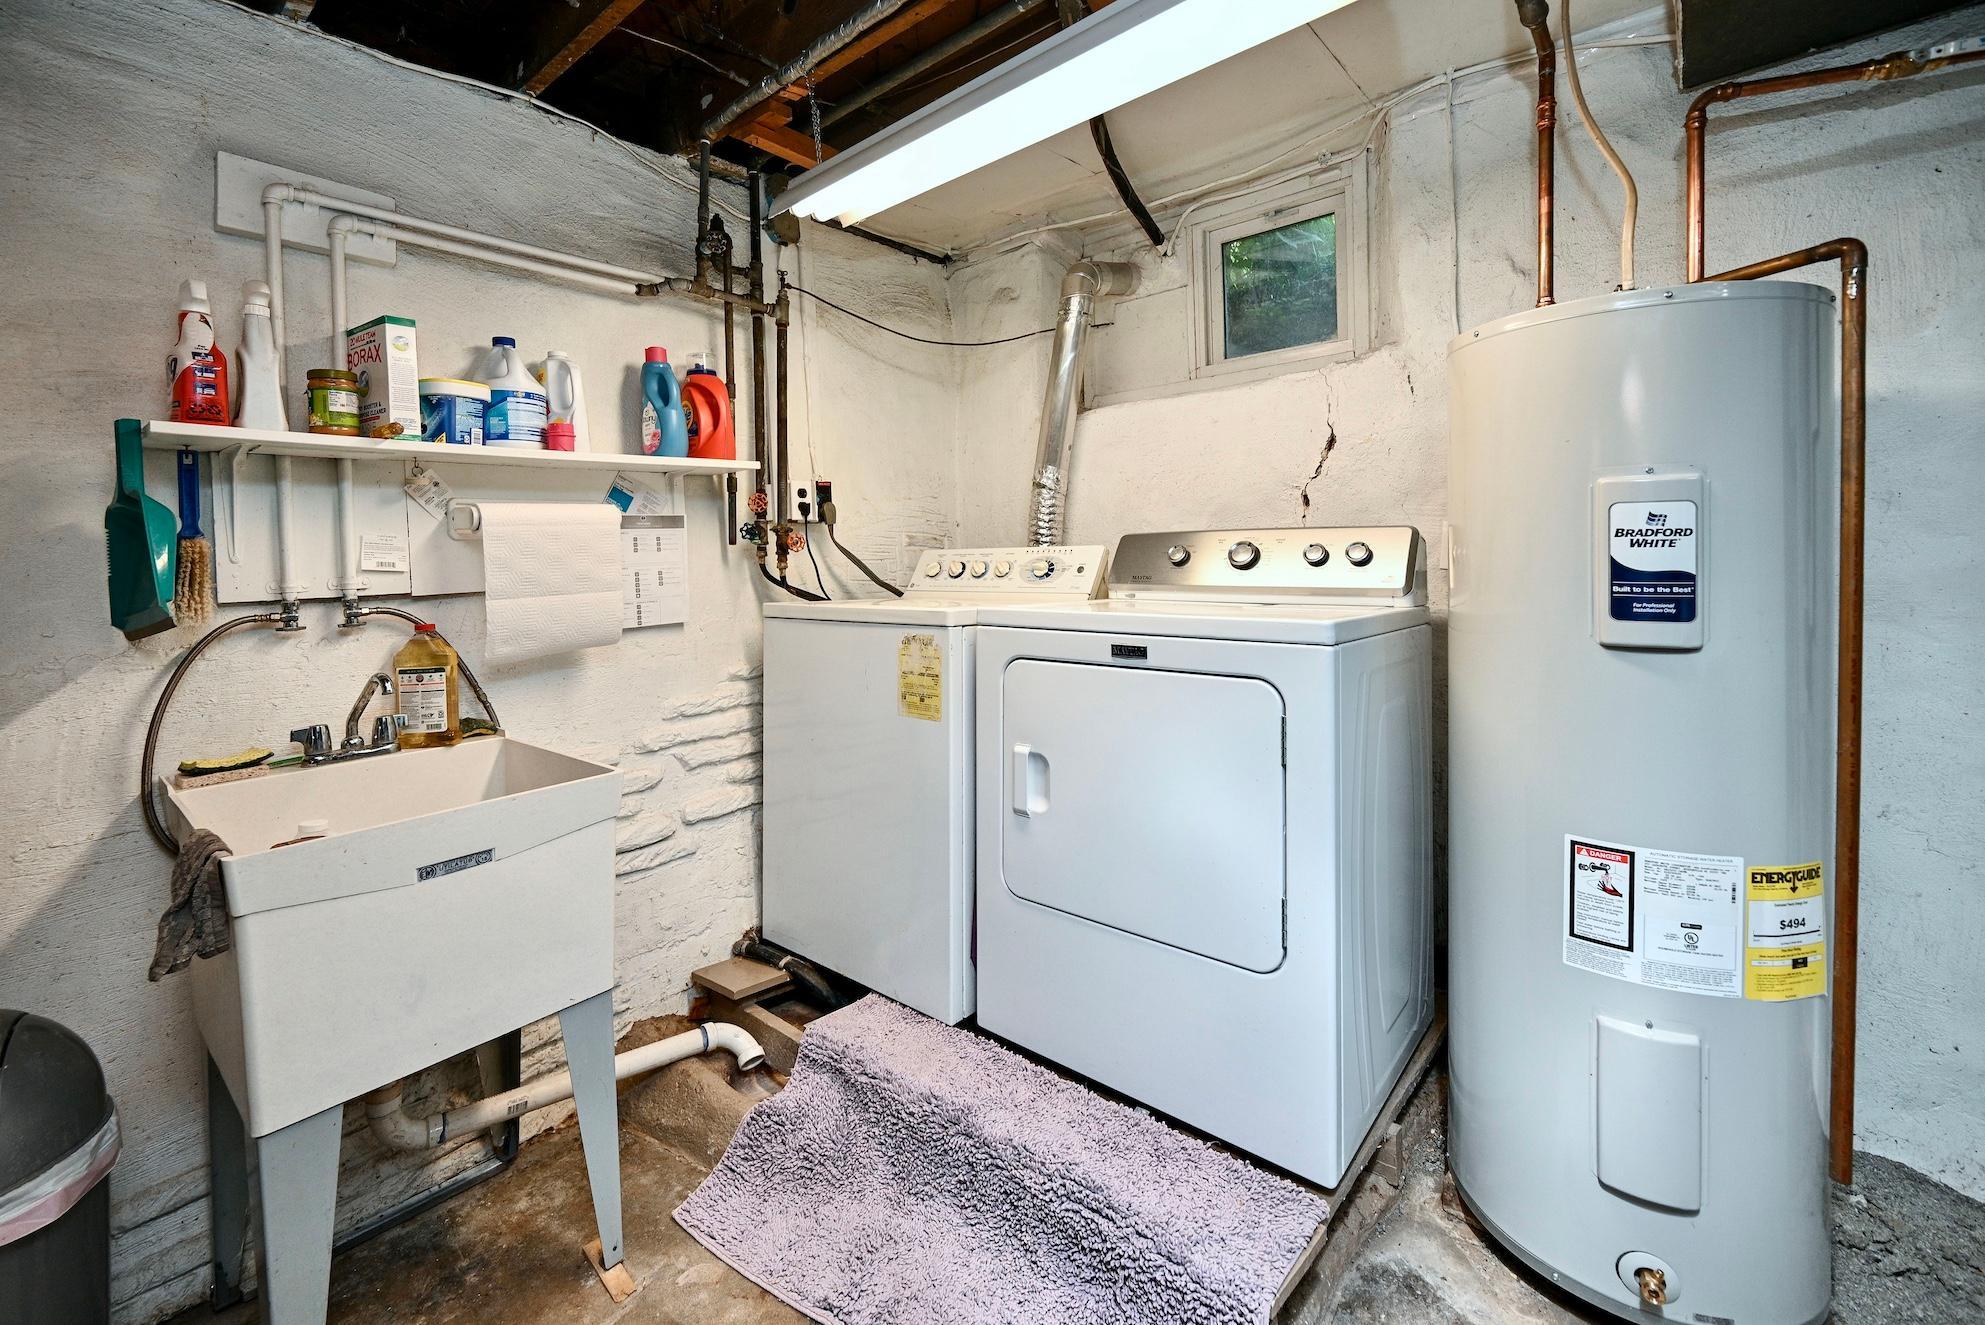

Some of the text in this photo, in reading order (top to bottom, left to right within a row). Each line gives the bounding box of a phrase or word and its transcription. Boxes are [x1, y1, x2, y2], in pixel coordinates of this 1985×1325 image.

[349, 337, 355, 347] 20
[347, 343, 382, 372] BORAX
[1614, 527, 1693, 538] BRADFORD
[1629, 538, 1678, 548] WHITE
[1612, 585, 1631, 593] Built
[1590, 851, 1622, 862] DANGER
[1751, 866, 1821, 884] ENERGYGUIDE
[1780, 917, 1806, 930] $494
